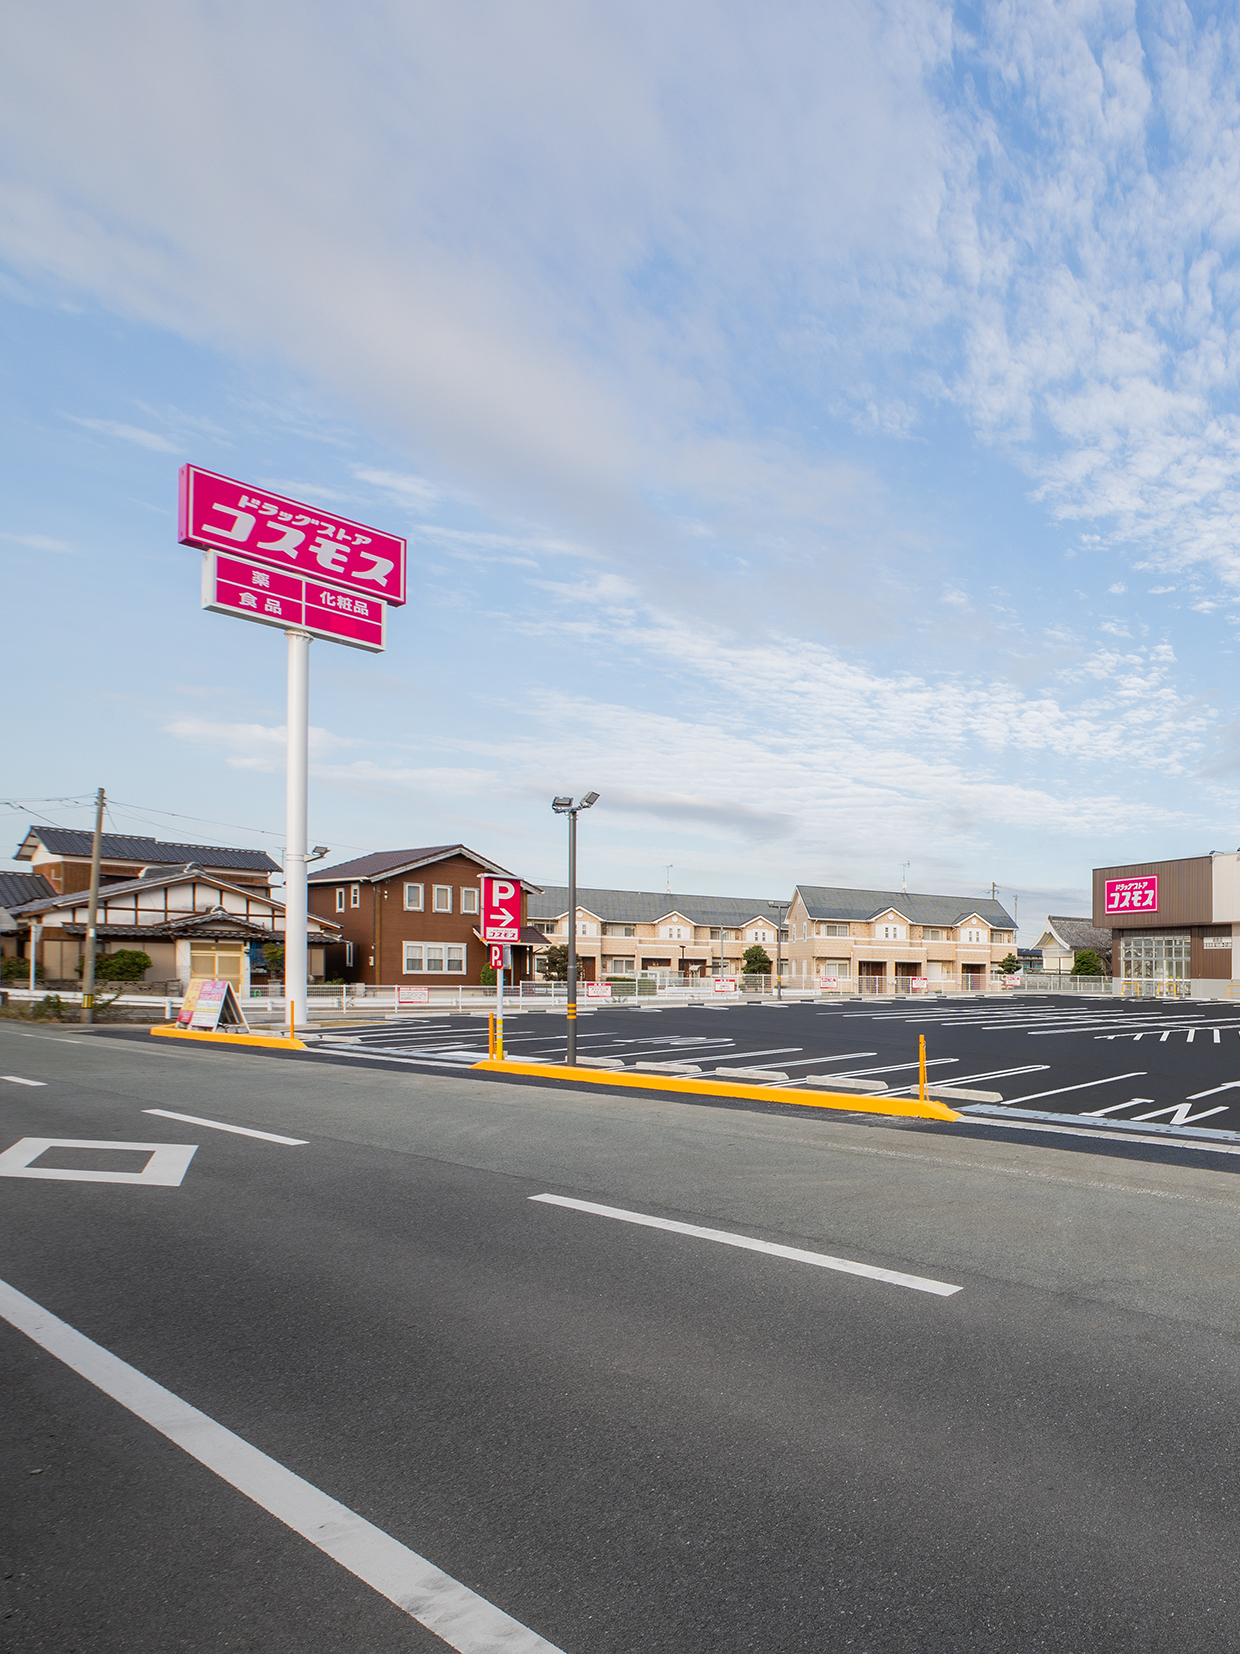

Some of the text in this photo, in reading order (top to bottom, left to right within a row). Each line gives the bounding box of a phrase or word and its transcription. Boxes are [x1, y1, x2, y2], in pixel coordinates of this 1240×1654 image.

[237, 494, 372, 546] ドラッグストア
[201, 502, 395, 588] コスモス
[251, 569, 270, 589] 薬
[238, 591, 282, 616] 食品
[319, 590, 369, 617] 化粧品
[492, 880, 515, 907] P
[1108, 889, 1155, 909] コスモス
[1115, 881, 1148, 892] ドラッグストア
[492, 946, 500, 967] P
[1079, 1097, 1230, 1126] IN
